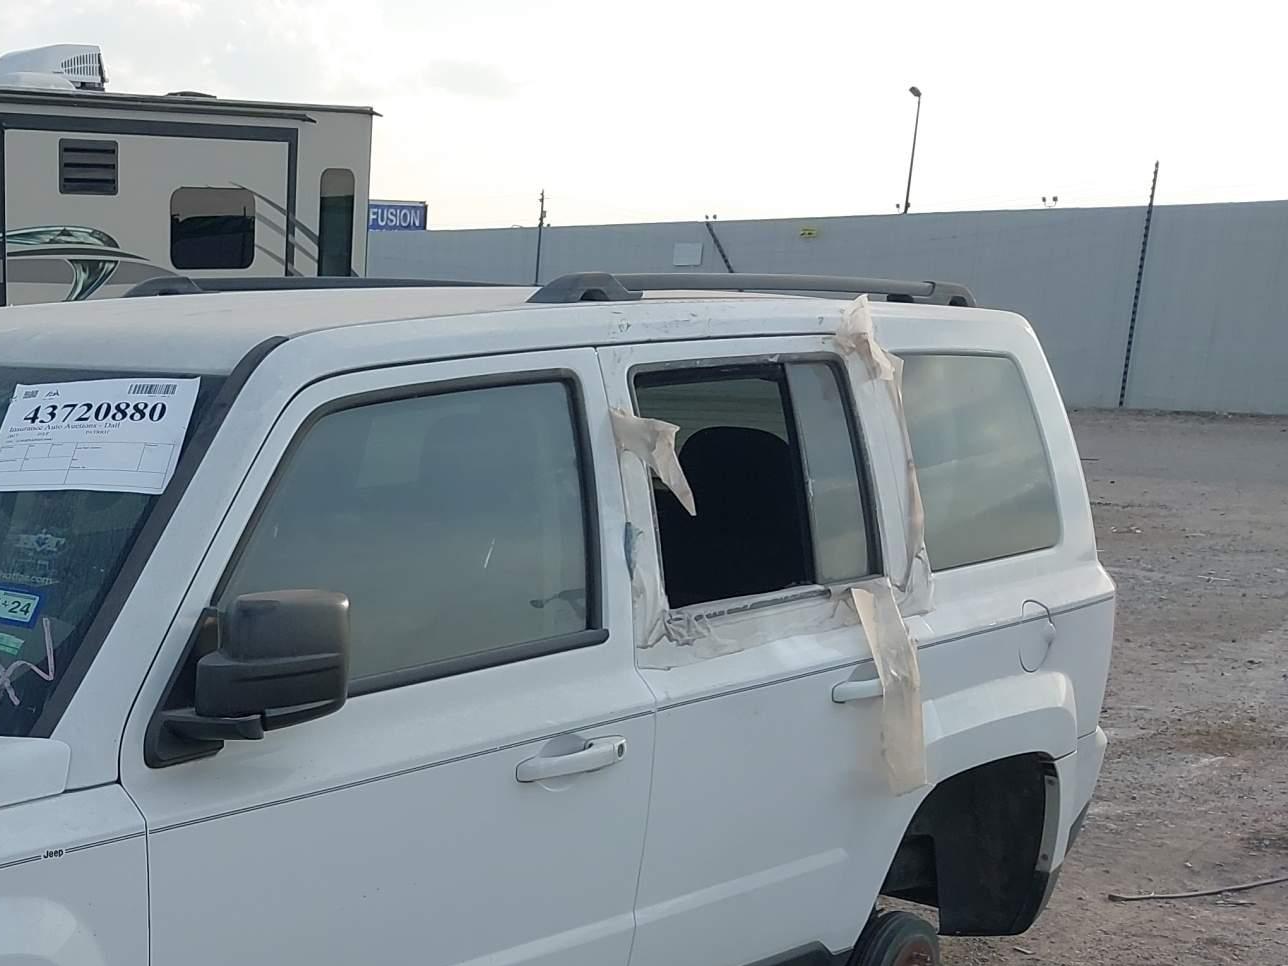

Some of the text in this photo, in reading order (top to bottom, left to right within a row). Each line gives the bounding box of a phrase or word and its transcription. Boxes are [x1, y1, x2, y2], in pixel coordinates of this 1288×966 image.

[369, 208, 420, 227] FUSION
[23, 401, 167, 424] 43720880
[8, 600, 32, 616] 24
[43, 849, 64, 858] Jeep
